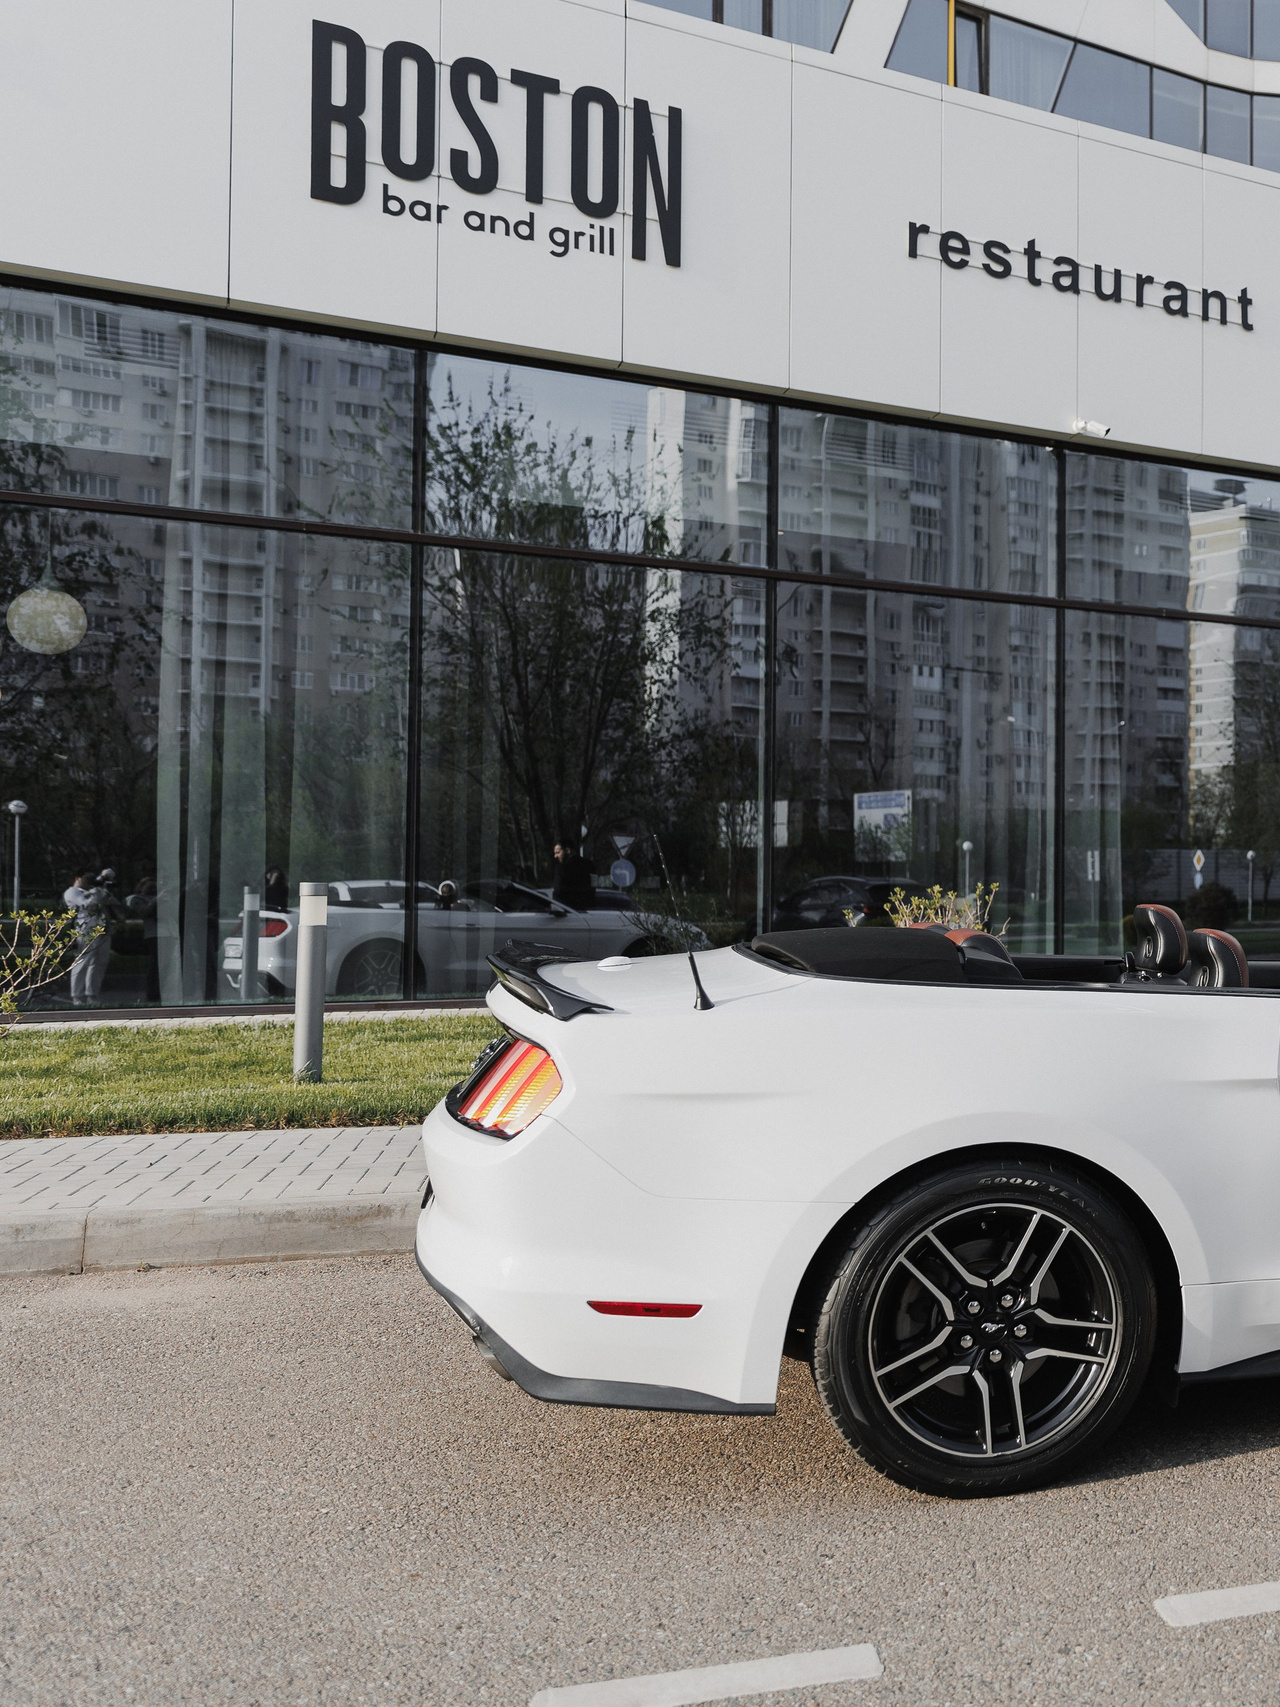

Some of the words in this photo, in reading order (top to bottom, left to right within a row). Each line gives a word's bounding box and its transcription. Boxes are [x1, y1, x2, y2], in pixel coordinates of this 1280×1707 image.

[310, 18, 683, 269] BOSTON
[382, 183, 450, 224] bar
[463, 211, 535, 241] and
[548, 223, 615, 258] grill
[908, 221, 1255, 332] restaurant
